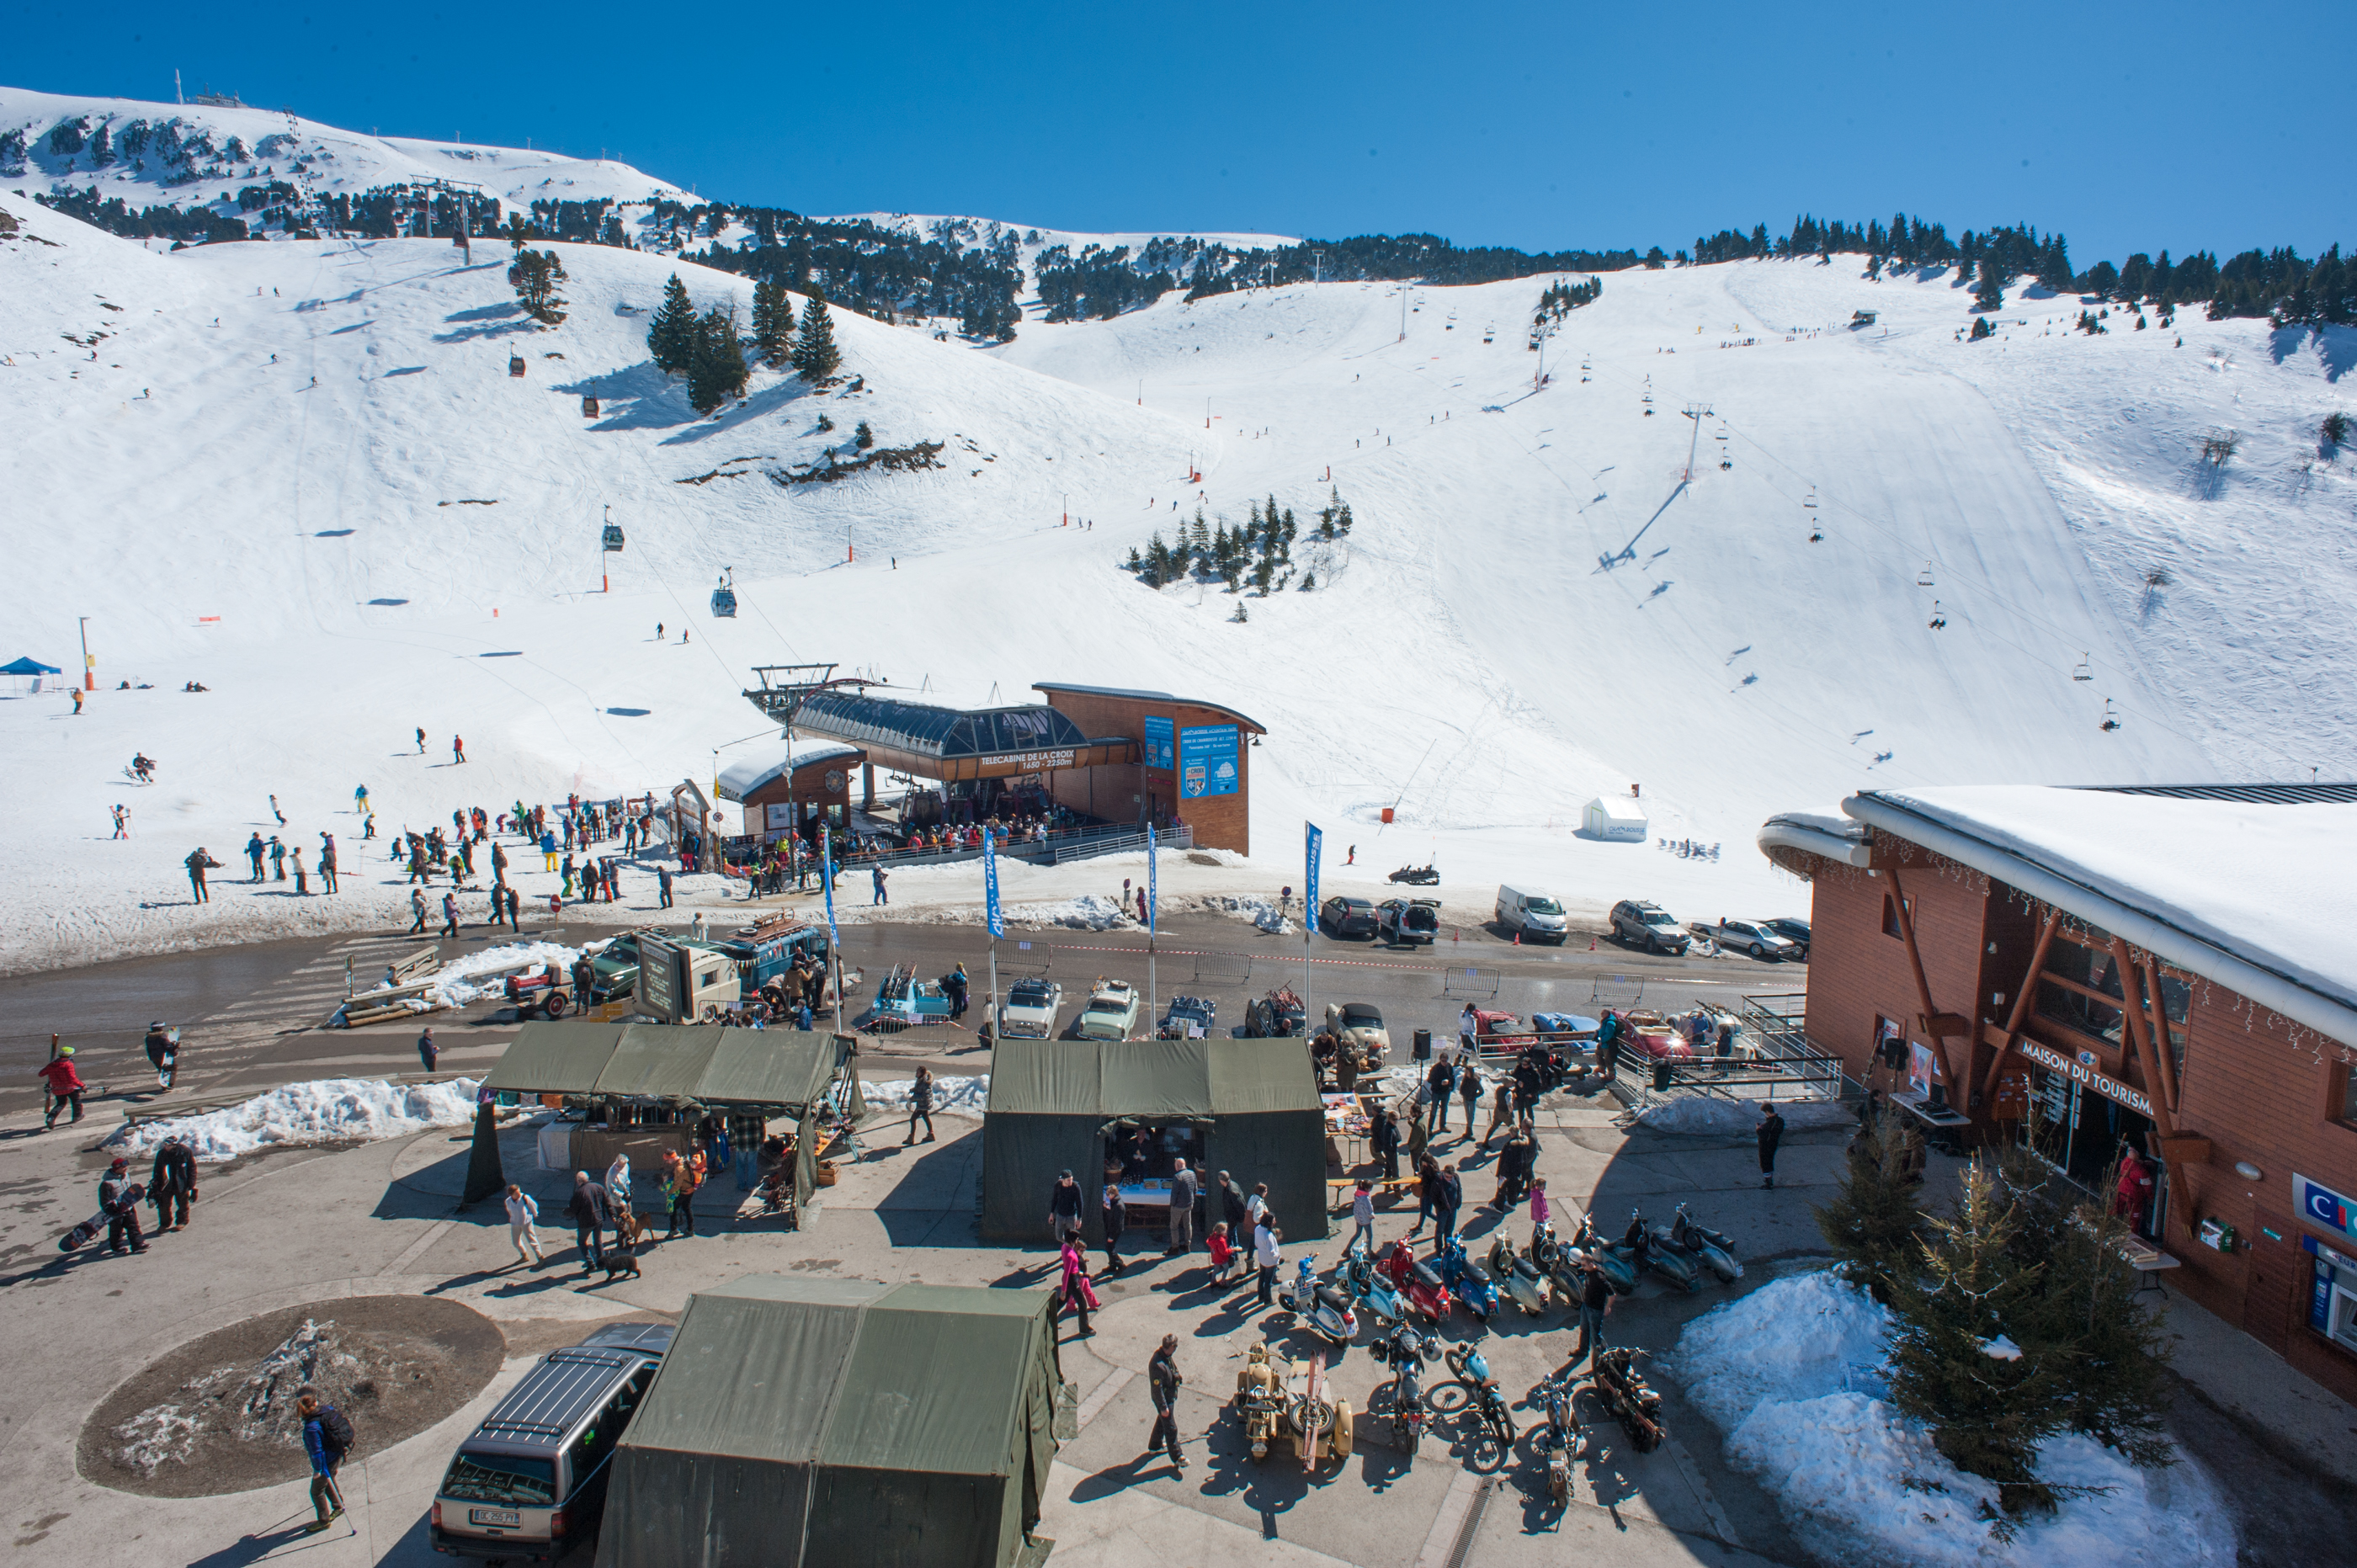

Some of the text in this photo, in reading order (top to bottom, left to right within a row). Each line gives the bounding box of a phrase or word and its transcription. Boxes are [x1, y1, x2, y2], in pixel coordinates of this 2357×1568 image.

[982, 754, 1025, 765] TELECABINE
[1039, 752, 1048, 760] LA
[1050, 750, 1074, 758] CROIX
[1045, 758, 1072, 767] 2250m
[987, 839, 1003, 935] CHAROUSSE
[2022, 1041, 2153, 1116] MAISON DU TOURISM
[2312, 1195, 2357, 1230] CI
